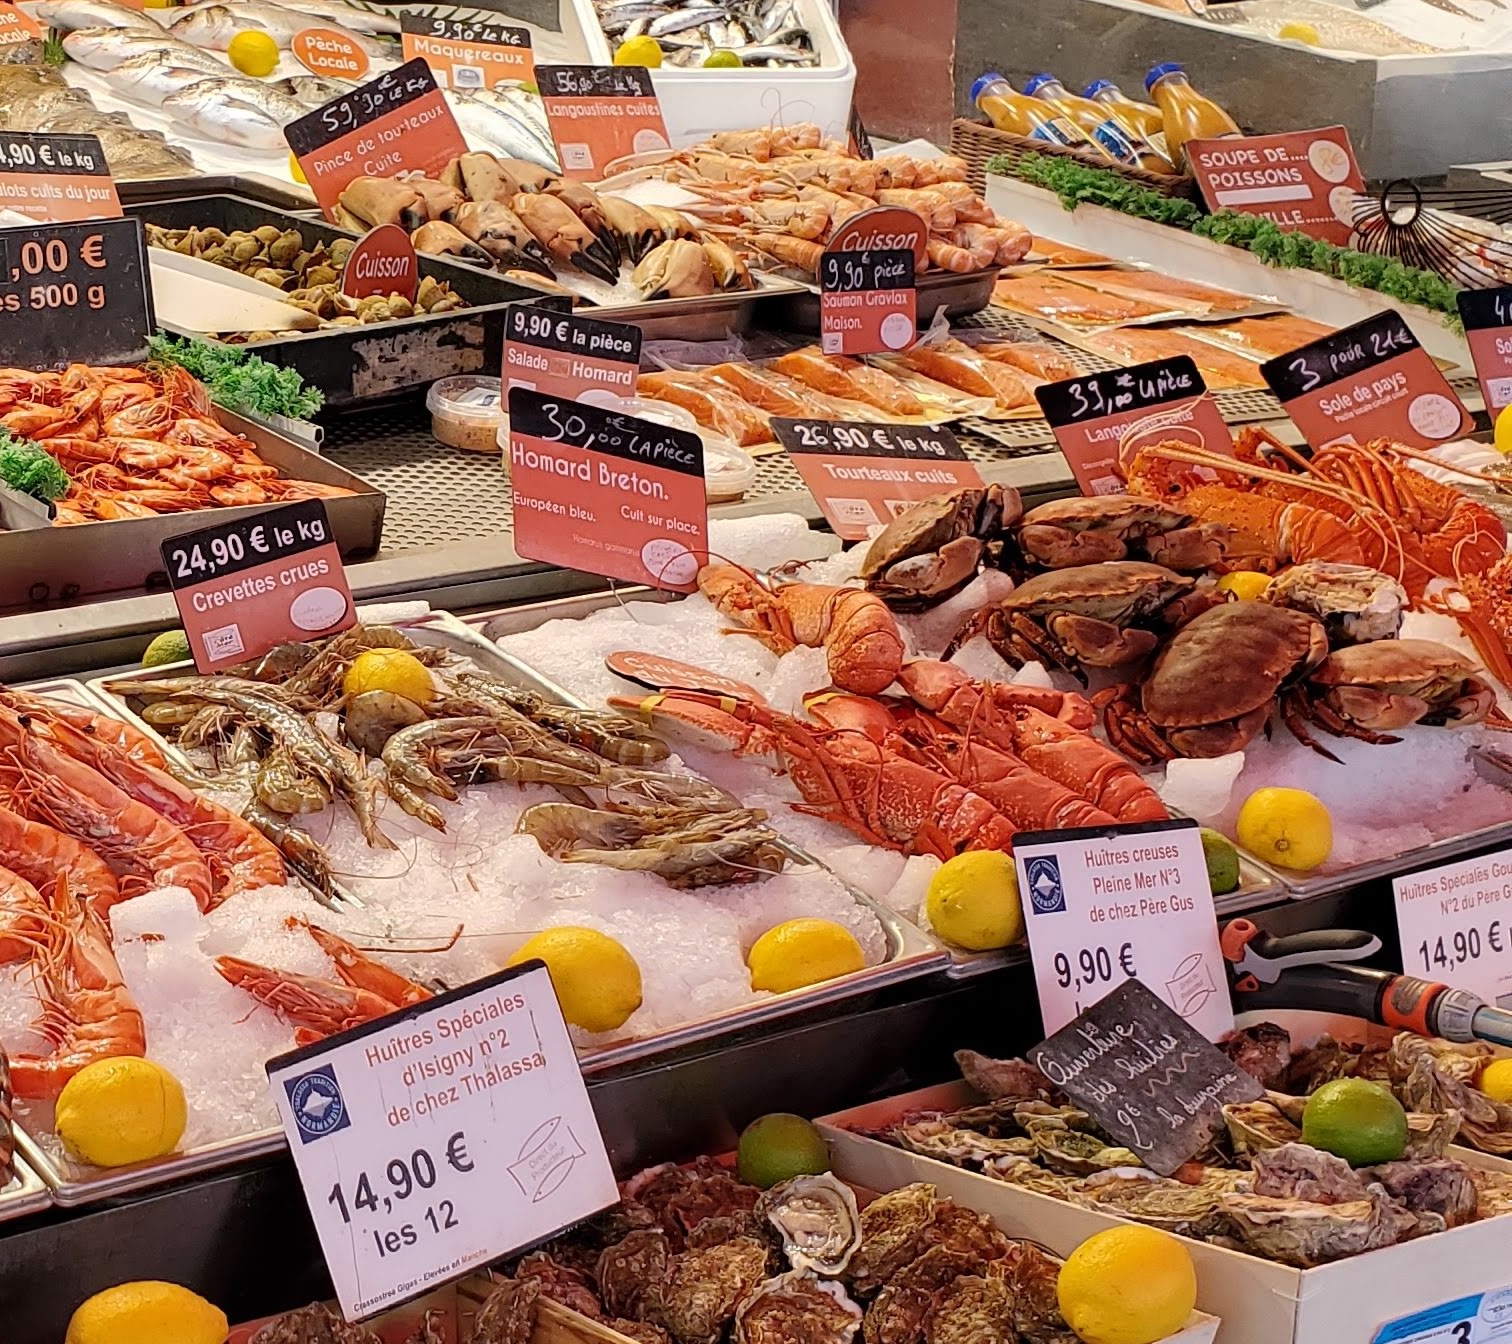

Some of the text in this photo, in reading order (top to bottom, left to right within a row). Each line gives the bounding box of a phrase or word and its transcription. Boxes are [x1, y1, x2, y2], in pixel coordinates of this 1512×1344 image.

[304, 35, 353, 55] Pêche
[413, 37, 525, 66] Maquereaux
[308, 52, 359, 72] Locale
[39, 144, 57, 167] €
[59, 153, 73, 167] le
[75, 153, 95, 172] kg
[364, 150, 403, 178] Cuite
[1208, 166, 1304, 190] POISSONS
[30, 184, 64, 200] cuits
[66, 185, 84, 201] du
[85, 186, 112, 203] jour
[841, 229, 918, 253] Cuisson
[355, 251, 410, 279] Cuisson
[30, 283, 78, 309] 500
[87, 284, 106, 309] g
[823, 291, 908, 308] Saumon Gravlax
[513, 311, 633, 355] 9,90 € la pièce
[507, 346, 633, 386] Salade Homard
[1319, 371, 1408, 417] Sole de pays
[822, 463, 959, 486] Tourteaux cuits
[192, 558, 330, 613] Crevettes crues
[1084, 843, 1180, 868] Huîtres creuses
[1093, 868, 1181, 896] Pleine Mer N°3
[1399, 867, 1489, 903] Huîtres Spéciales
[1089, 892, 1194, 923] de chez Père Gus
[1419, 920, 1504, 973] 14,90 €
[1054, 941, 1137, 989] 9,90 €
[364, 991, 525, 1068] Huîtres Spéciales
[387, 1050, 546, 1128] de chez Thalassa
[327, 1147, 437, 1224] 14,90
[445, 1131, 475, 1173] €
[373, 1199, 459, 1258] les 12
